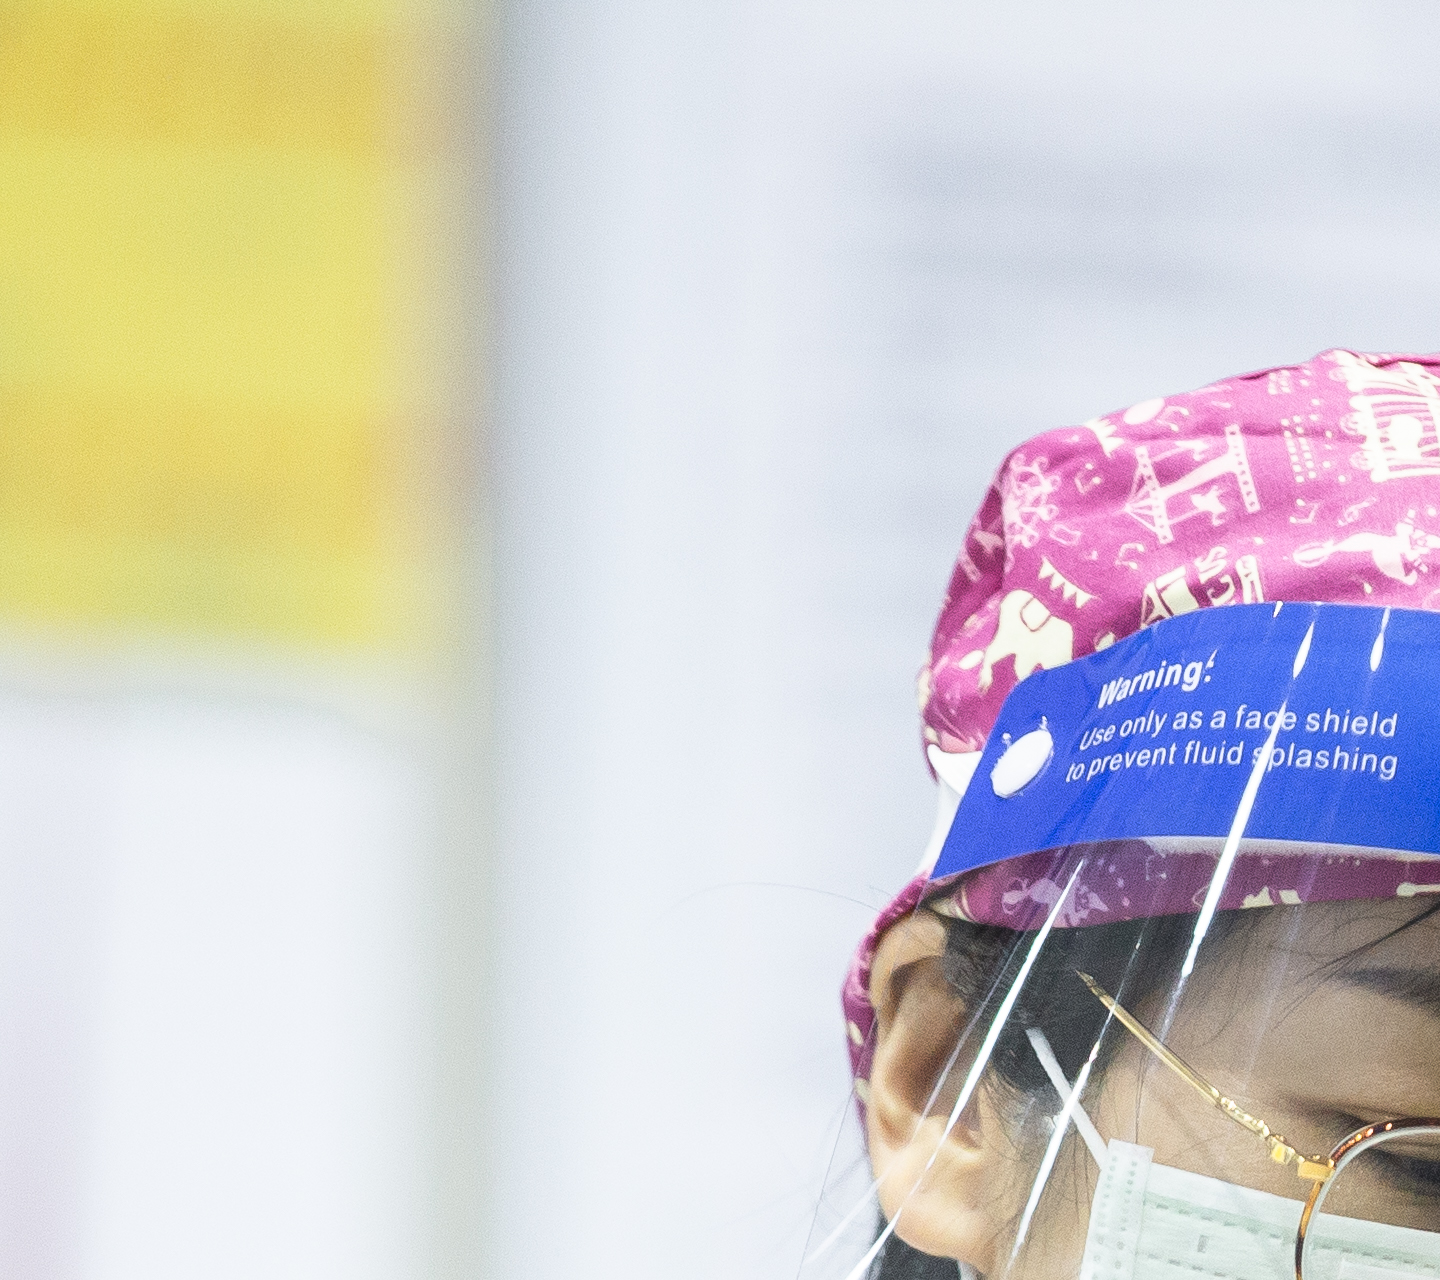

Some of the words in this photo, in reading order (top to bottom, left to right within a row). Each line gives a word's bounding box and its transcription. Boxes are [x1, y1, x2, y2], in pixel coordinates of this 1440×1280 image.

[1097, 649, 1217, 709] Warning!
[1080, 727, 1114, 751] Use
[1120, 709, 1168, 738] only
[1172, 711, 1203, 731] as
[1210, 711, 1227, 730] a
[1236, 705, 1297, 731] face
[1305, 708, 1398, 738] shield
[1065, 759, 1085, 783] to
[1087, 742, 1178, 782] prevent
[1184, 740, 1244, 766] fluid
[1252, 742, 1398, 781] splashing
